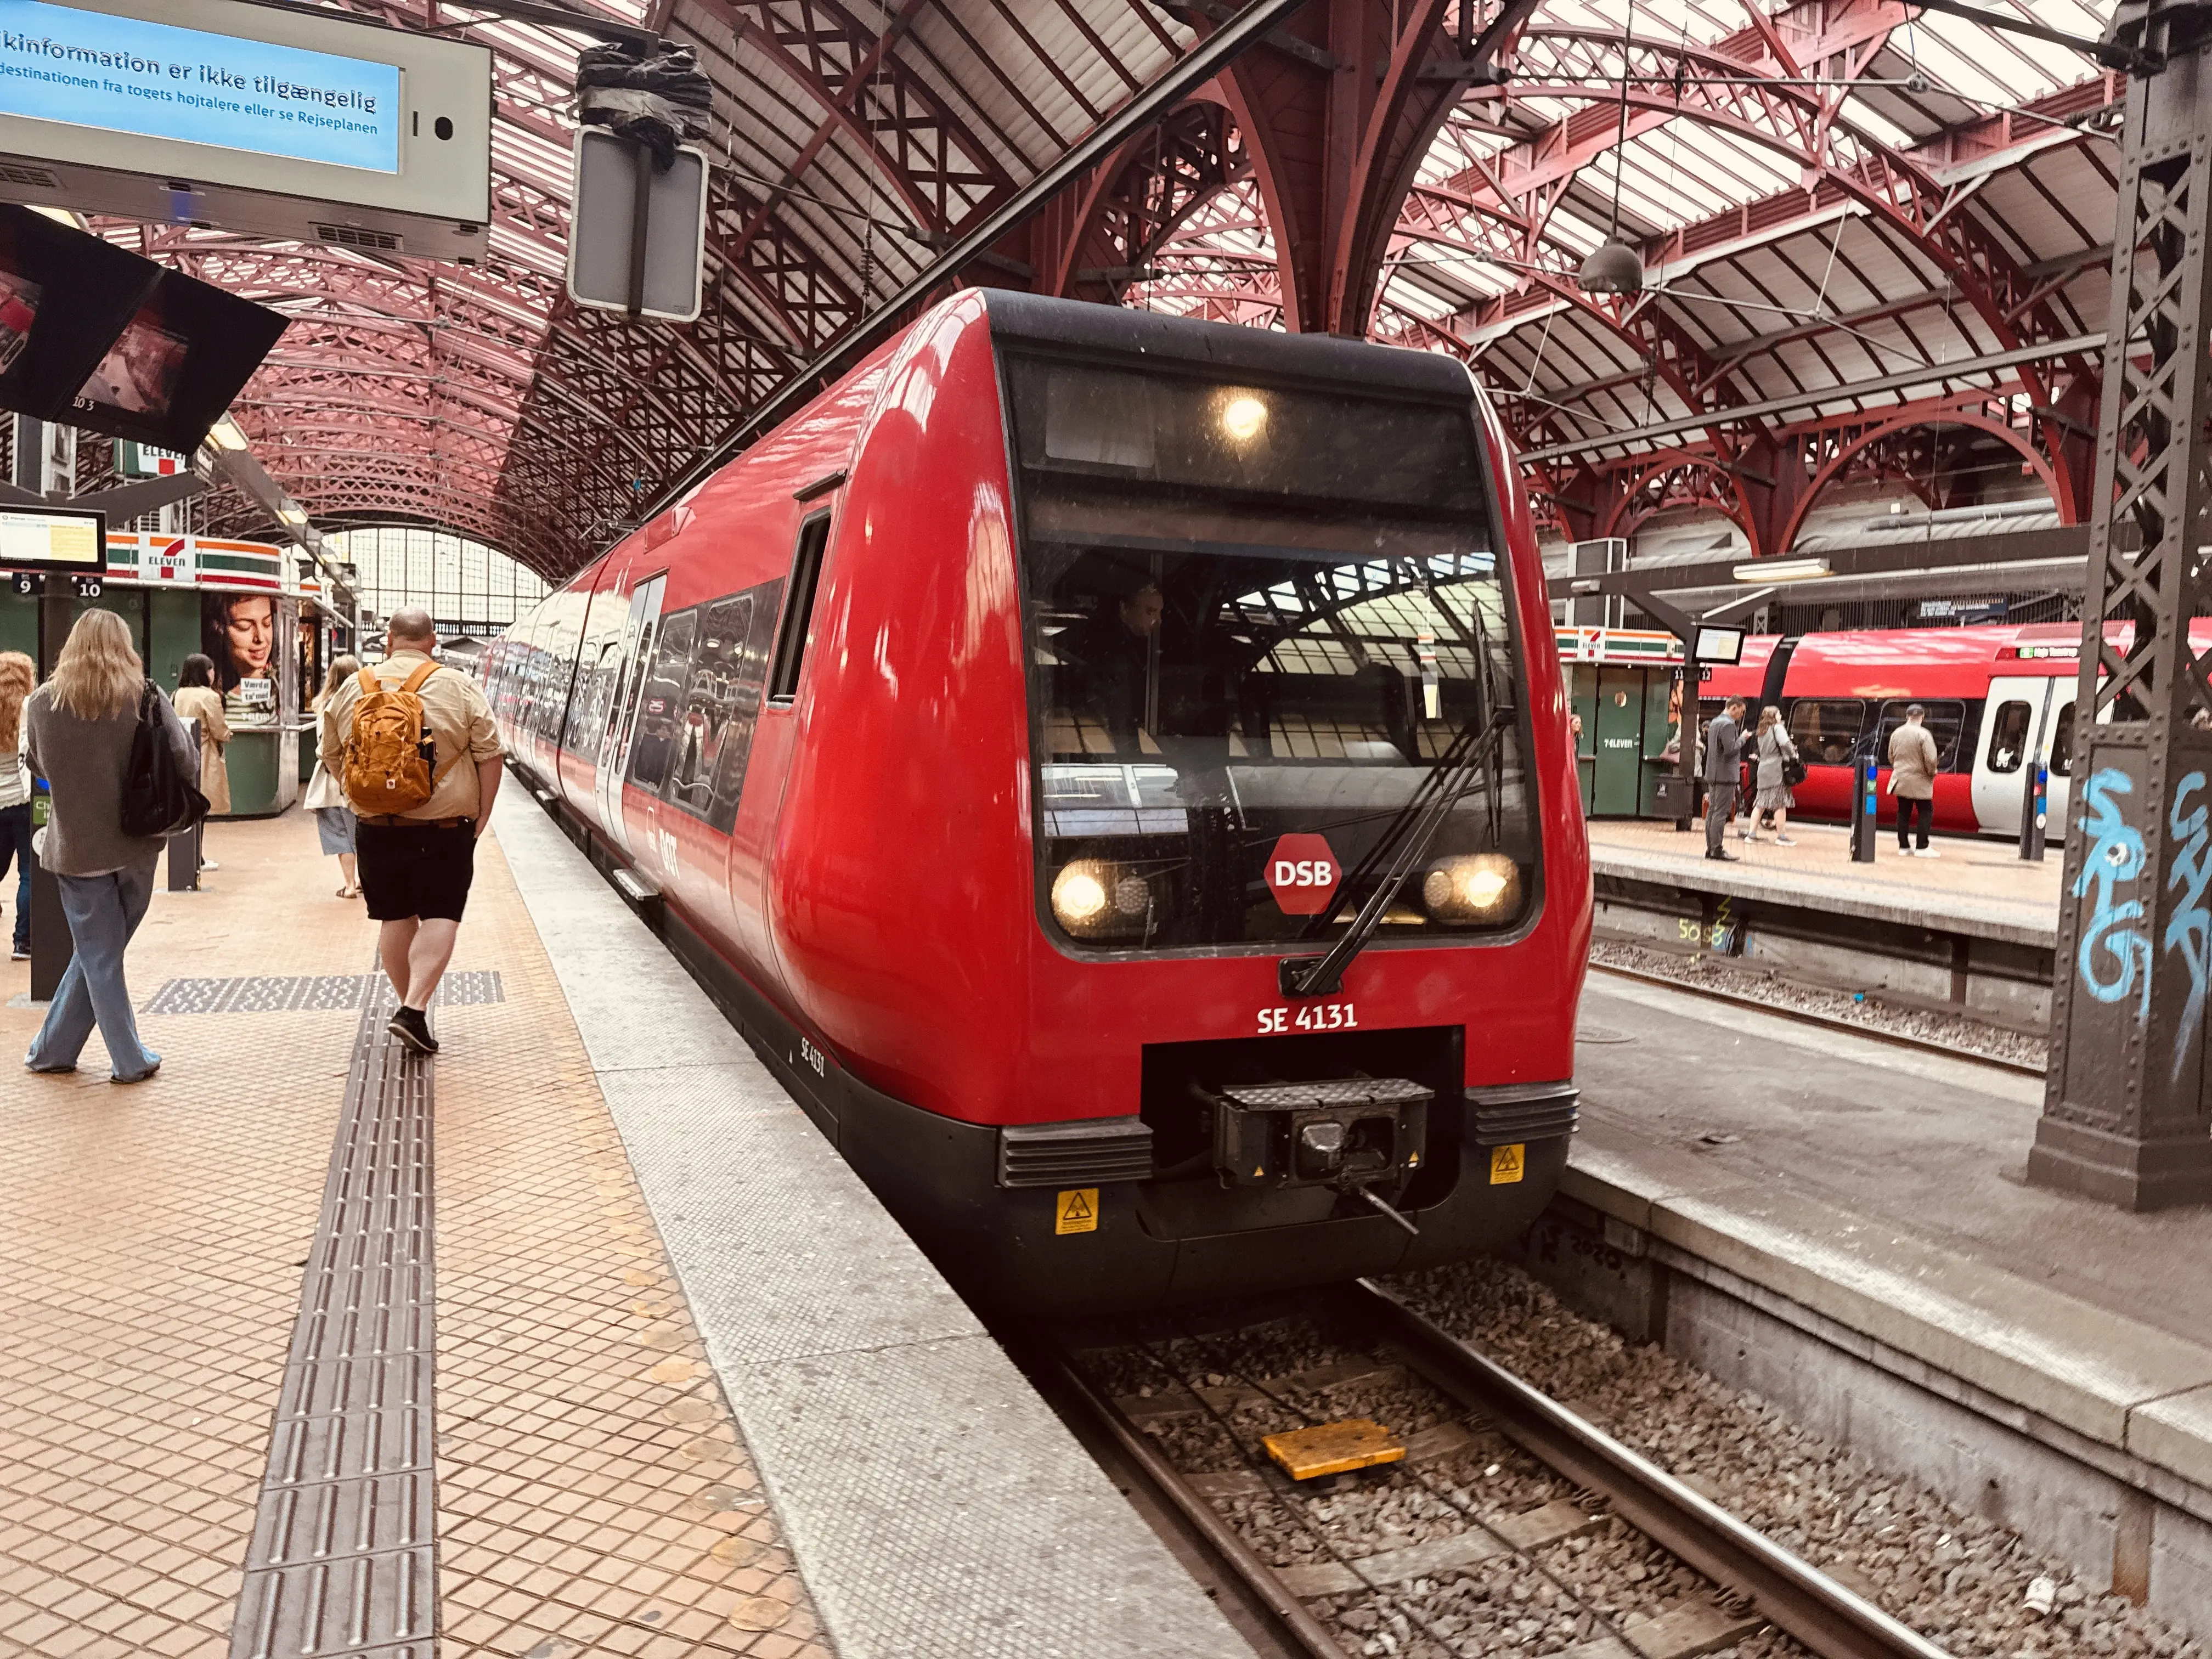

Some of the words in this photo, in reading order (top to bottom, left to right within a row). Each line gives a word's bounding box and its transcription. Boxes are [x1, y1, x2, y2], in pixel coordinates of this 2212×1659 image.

[0, 30, 160, 75] kinformation
[168, 64, 191, 80] er
[200, 65, 246, 89] ikke
[254, 76, 376, 114] tilgængelig
[103, 79, 122, 93] fra
[128, 85, 172, 101] togets
[245, 103, 274, 117] eller
[279, 110, 294, 121] se
[298, 111, 377, 134] Rejseplanen
[20, 580, 31, 593] 9
[80, 583, 101, 597] 10
[1275, 860, 1333, 887] DSB
[1257, 1007, 1289, 1034] SE
[1295, 1003, 1358, 1030] 4131
[801, 1036, 810, 1062] SE
[809, 1045, 825, 1079] 4131
